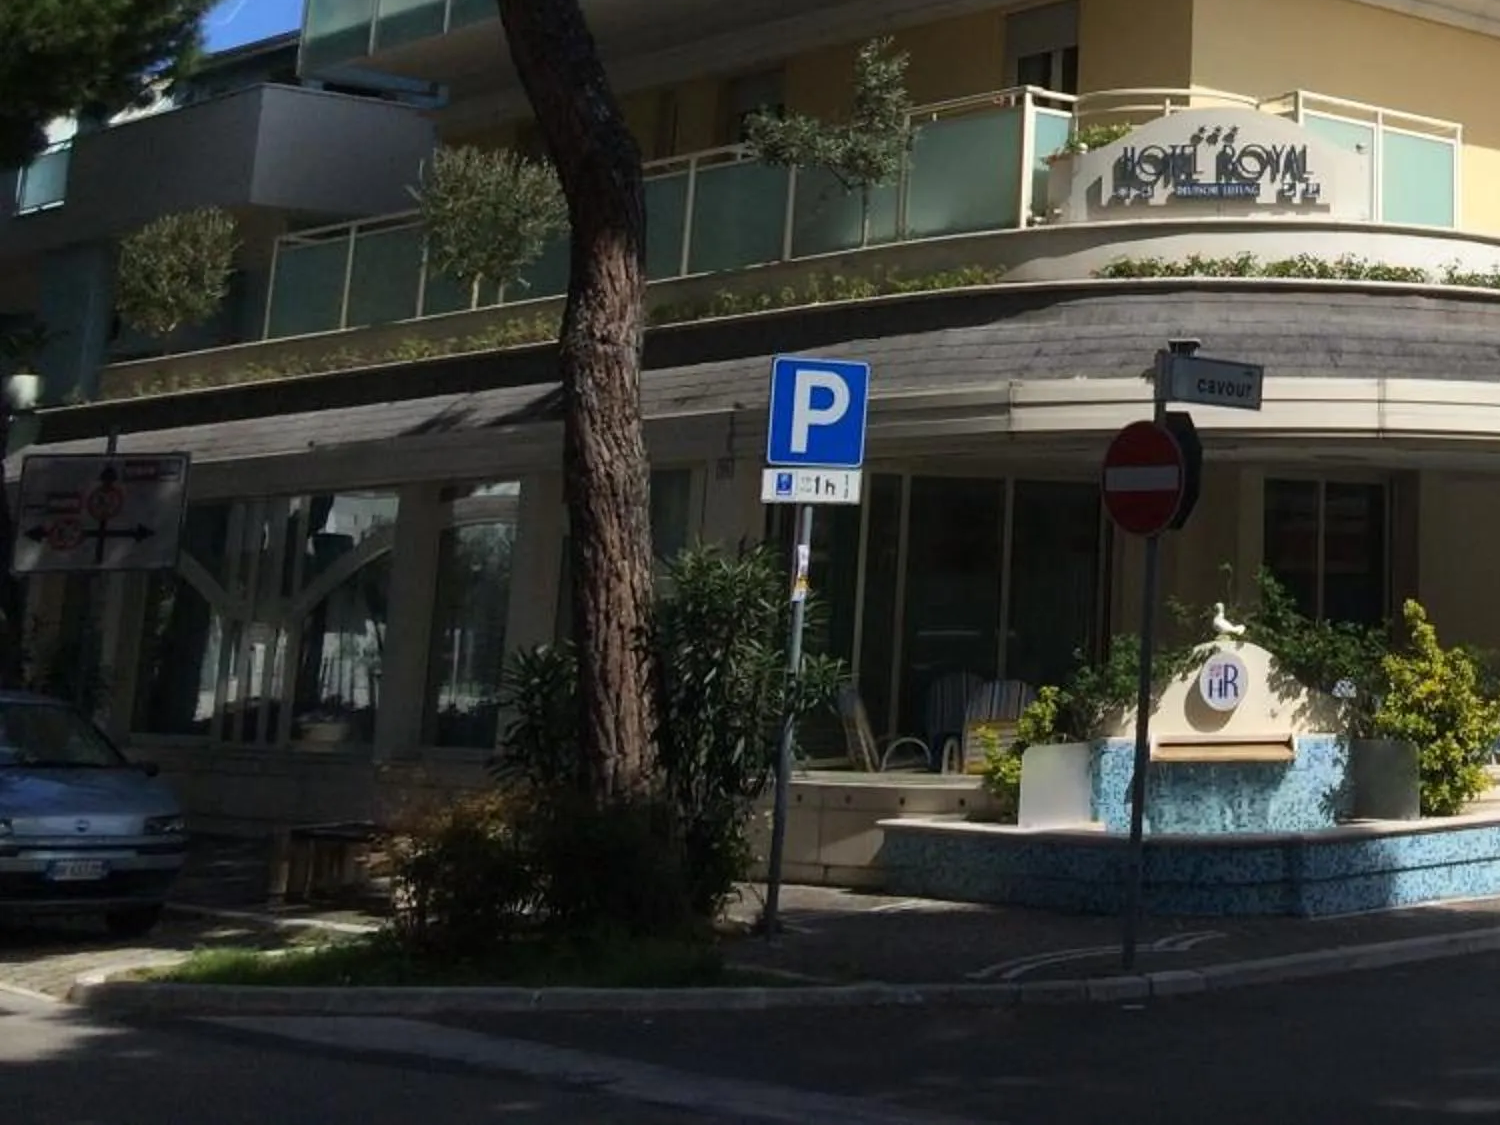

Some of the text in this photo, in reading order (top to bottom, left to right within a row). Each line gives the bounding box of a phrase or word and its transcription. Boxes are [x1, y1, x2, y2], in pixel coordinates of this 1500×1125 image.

[1121, 144, 1315, 179] HOTEL ROYAL
[790, 369, 850, 454] P
[1207, 663, 1240, 700] HR
